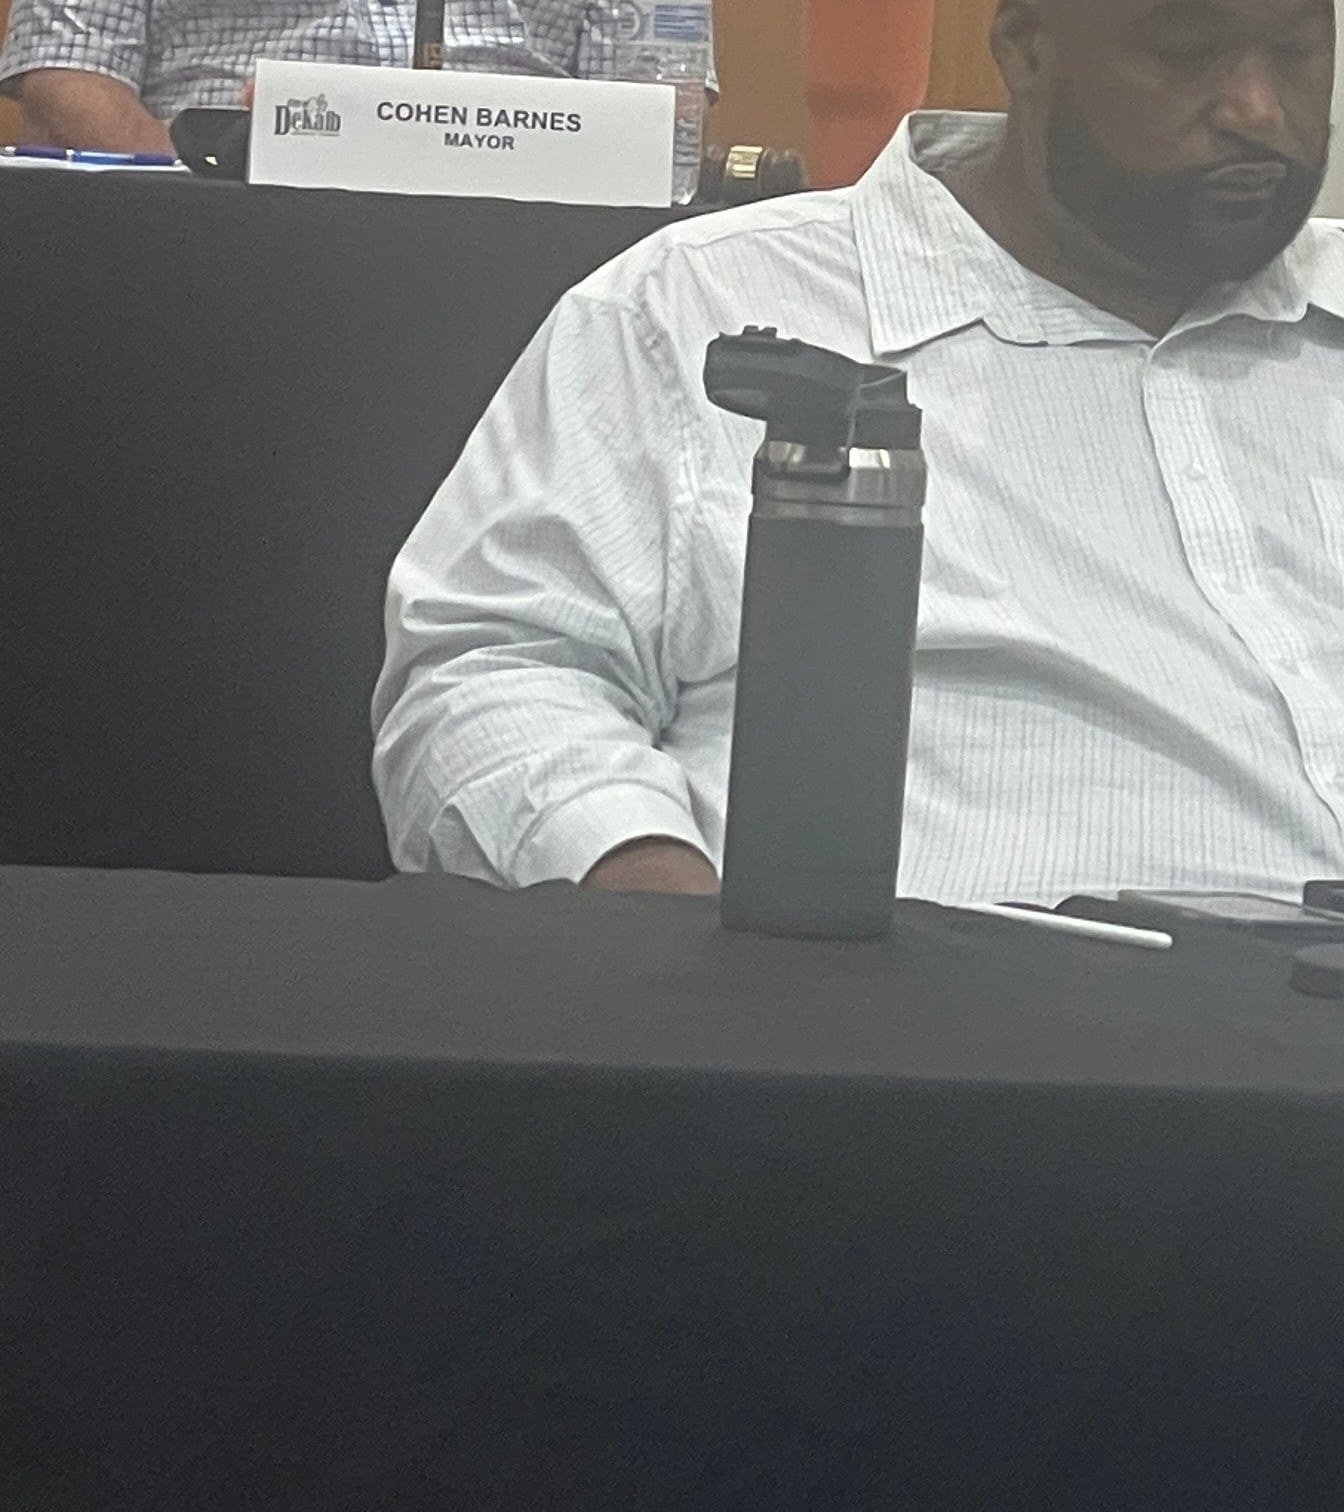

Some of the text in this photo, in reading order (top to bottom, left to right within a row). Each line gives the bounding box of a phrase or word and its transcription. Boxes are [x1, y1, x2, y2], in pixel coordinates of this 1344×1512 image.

[376, 101, 582, 132] COHEN BARNES
[444, 132, 515, 151] MAYOR
